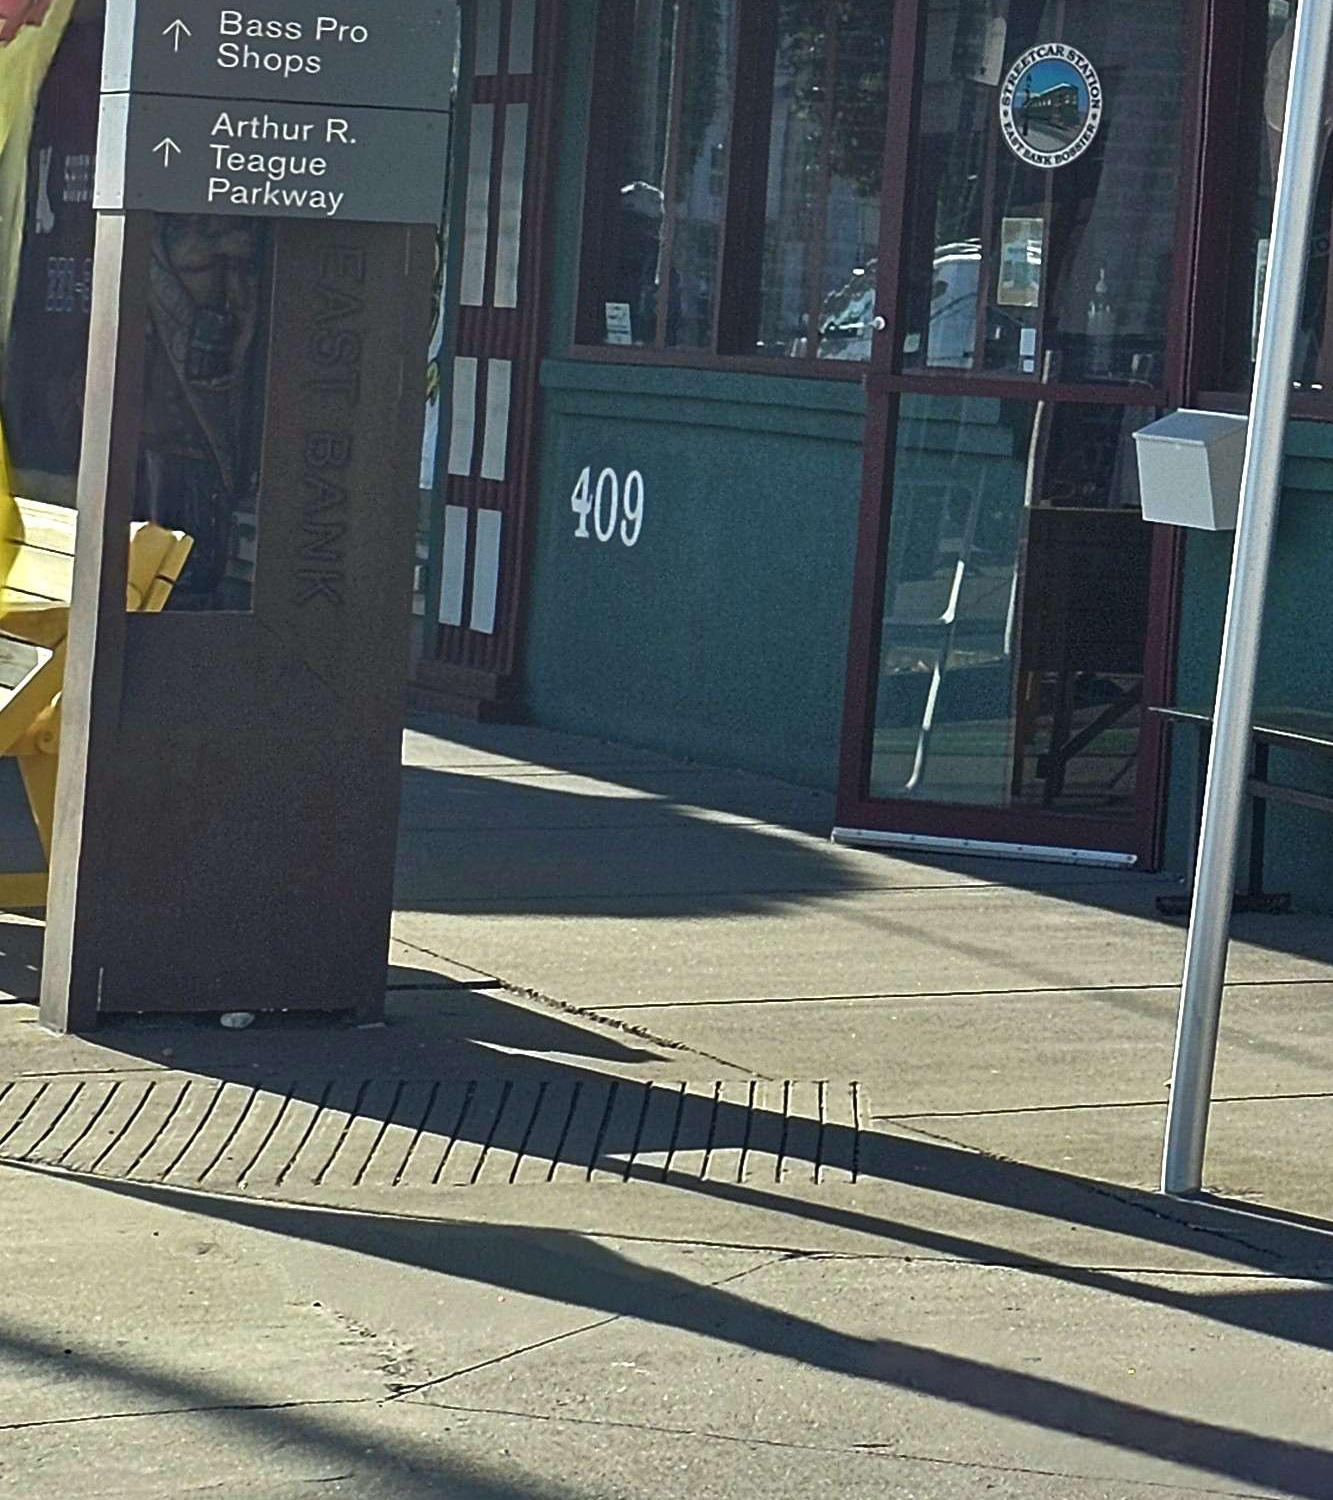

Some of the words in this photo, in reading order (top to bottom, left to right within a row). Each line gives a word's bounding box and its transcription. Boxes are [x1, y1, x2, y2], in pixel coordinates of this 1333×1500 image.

[220, 10, 302, 40] Bass
[315, 17, 369, 44] Pro
[216, 43, 322, 79] Shops
[1002, 46, 1064, 107] STREETCAR
[1067, 51, 1101, 109] STATION
[210, 112, 314, 142] Arthur
[325, 119, 356, 145] R.
[1004, 123, 1025, 152] EAST
[209, 144, 327, 181] Teague
[207, 179, 344, 216] Parkway
[305, 245, 367, 411] EAST
[293, 430, 353, 606] BANK
[570, 465, 644, 546] 409
